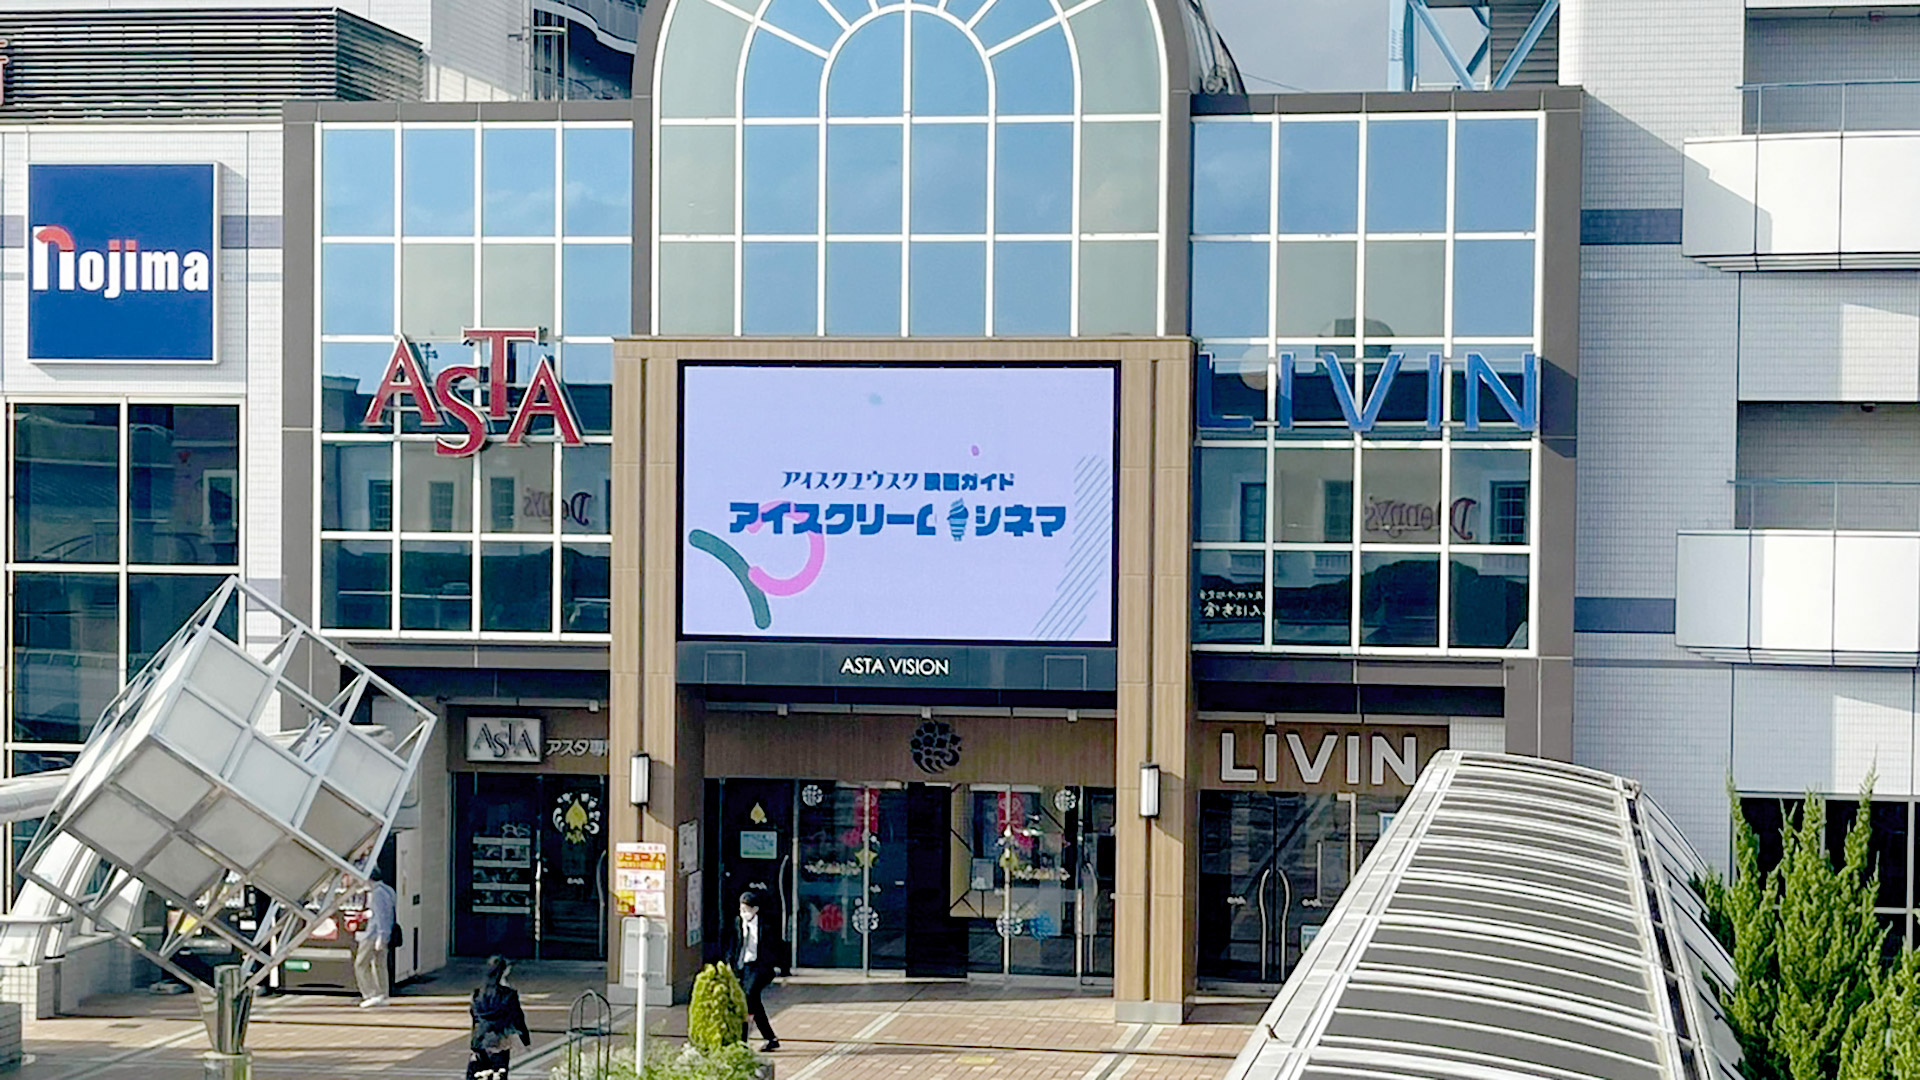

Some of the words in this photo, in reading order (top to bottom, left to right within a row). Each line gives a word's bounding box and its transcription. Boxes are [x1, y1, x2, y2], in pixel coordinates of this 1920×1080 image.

[32, 226, 209, 299] nojima
[361, 327, 584, 457] ASTA
[1198, 352, 1537, 431] LIVIN
[975, 505, 1066, 537] シネマ
[840, 657, 886, 675] ASTA
[889, 657, 949, 676] VISION
[472, 721, 538, 758] ASTA
[1221, 732, 1417, 786] LIVIN
